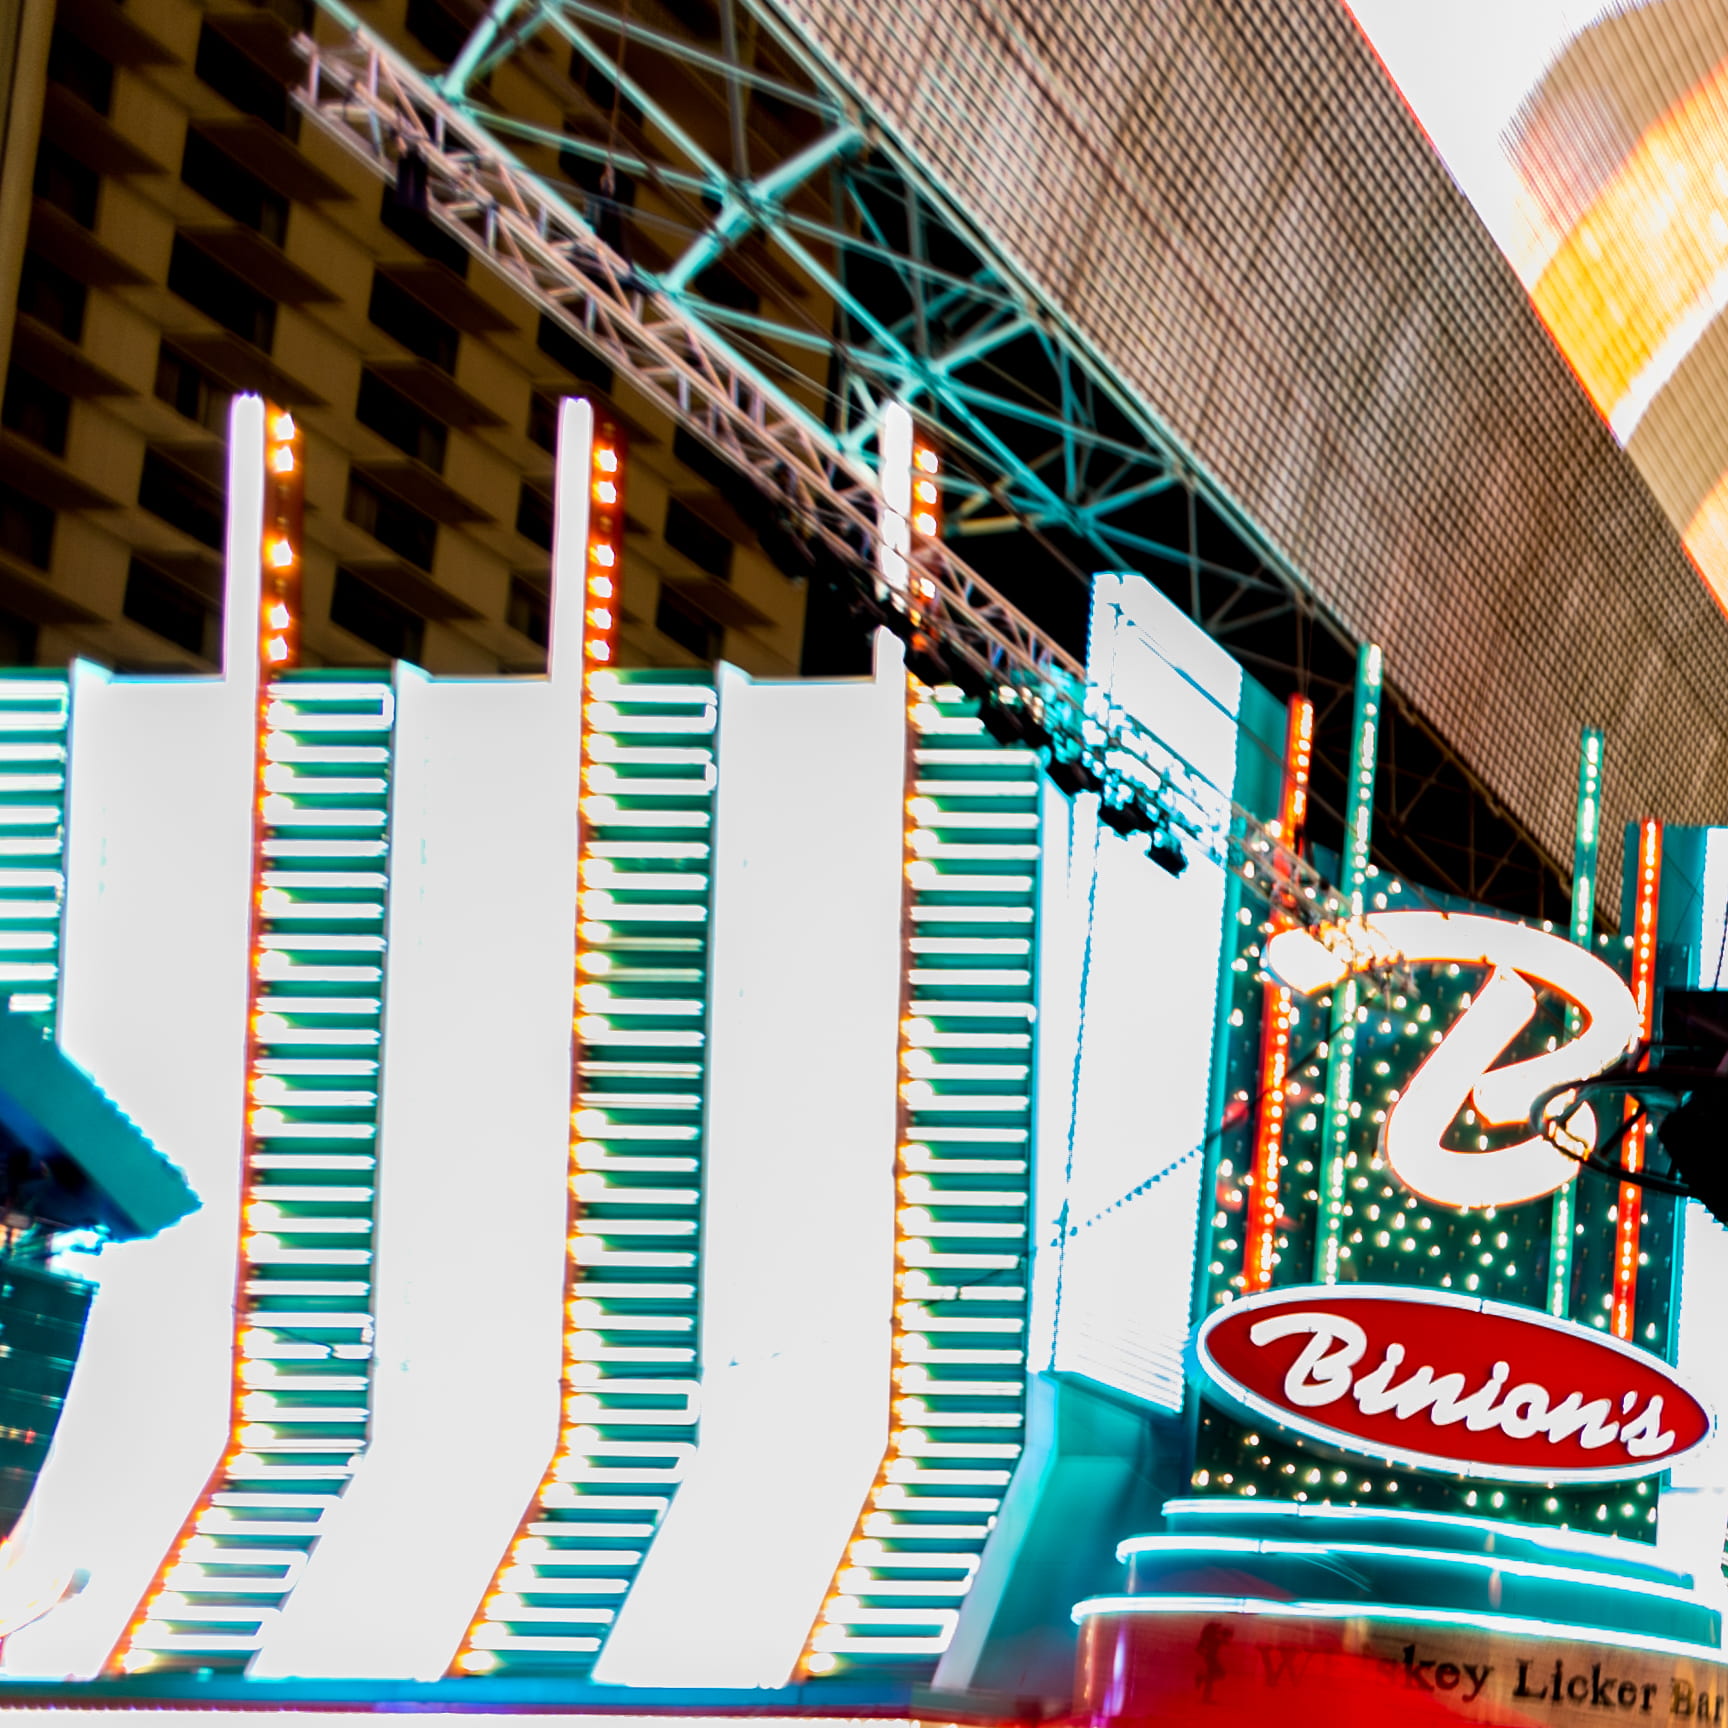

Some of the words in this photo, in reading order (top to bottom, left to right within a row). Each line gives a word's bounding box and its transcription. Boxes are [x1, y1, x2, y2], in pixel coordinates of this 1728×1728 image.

[1249, 1311, 1676, 1458] Binion's
[1256, 1644, 1494, 1703] Wskey
[1511, 1656, 1659, 1713] Licker
[1669, 1676, 1727, 1724] Bar
